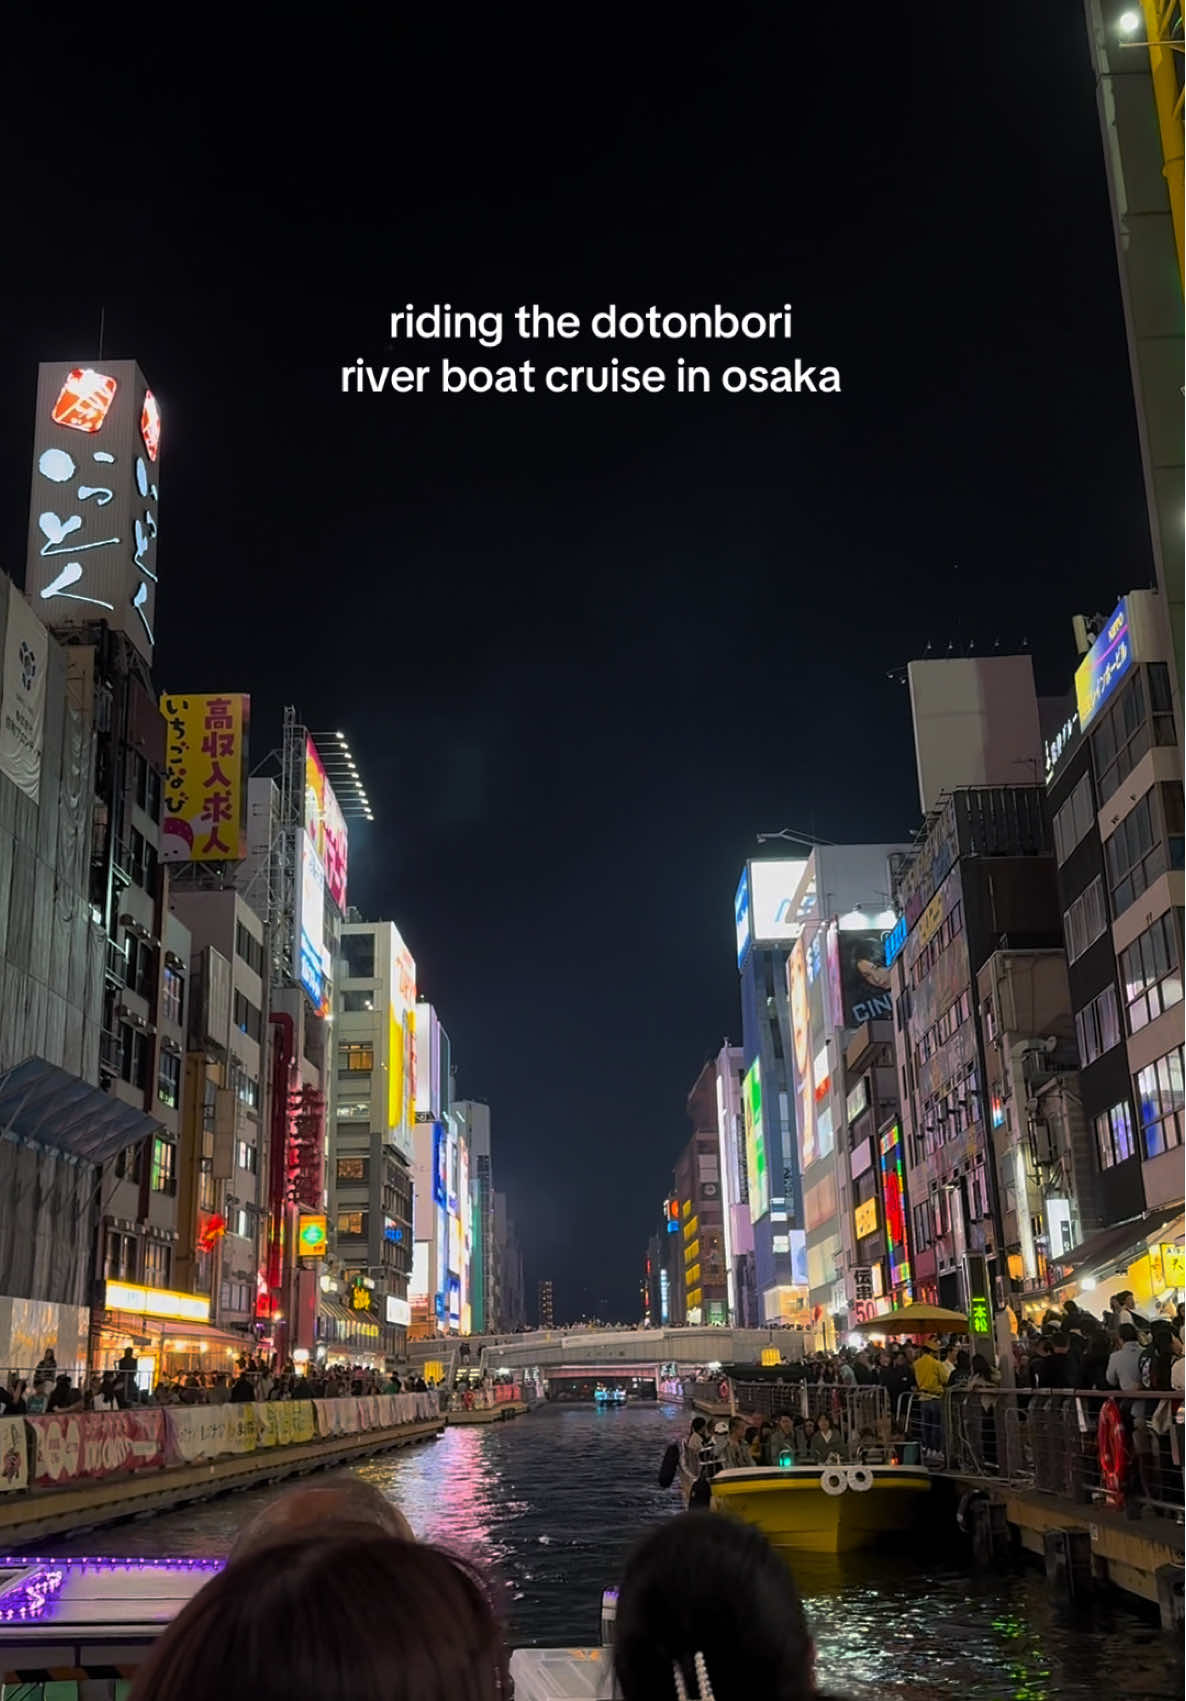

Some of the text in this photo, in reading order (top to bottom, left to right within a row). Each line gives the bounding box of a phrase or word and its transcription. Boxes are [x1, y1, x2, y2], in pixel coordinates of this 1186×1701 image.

[160, 698, 190, 813] いちごなび
[201, 697, 235, 854] 高収入求人
